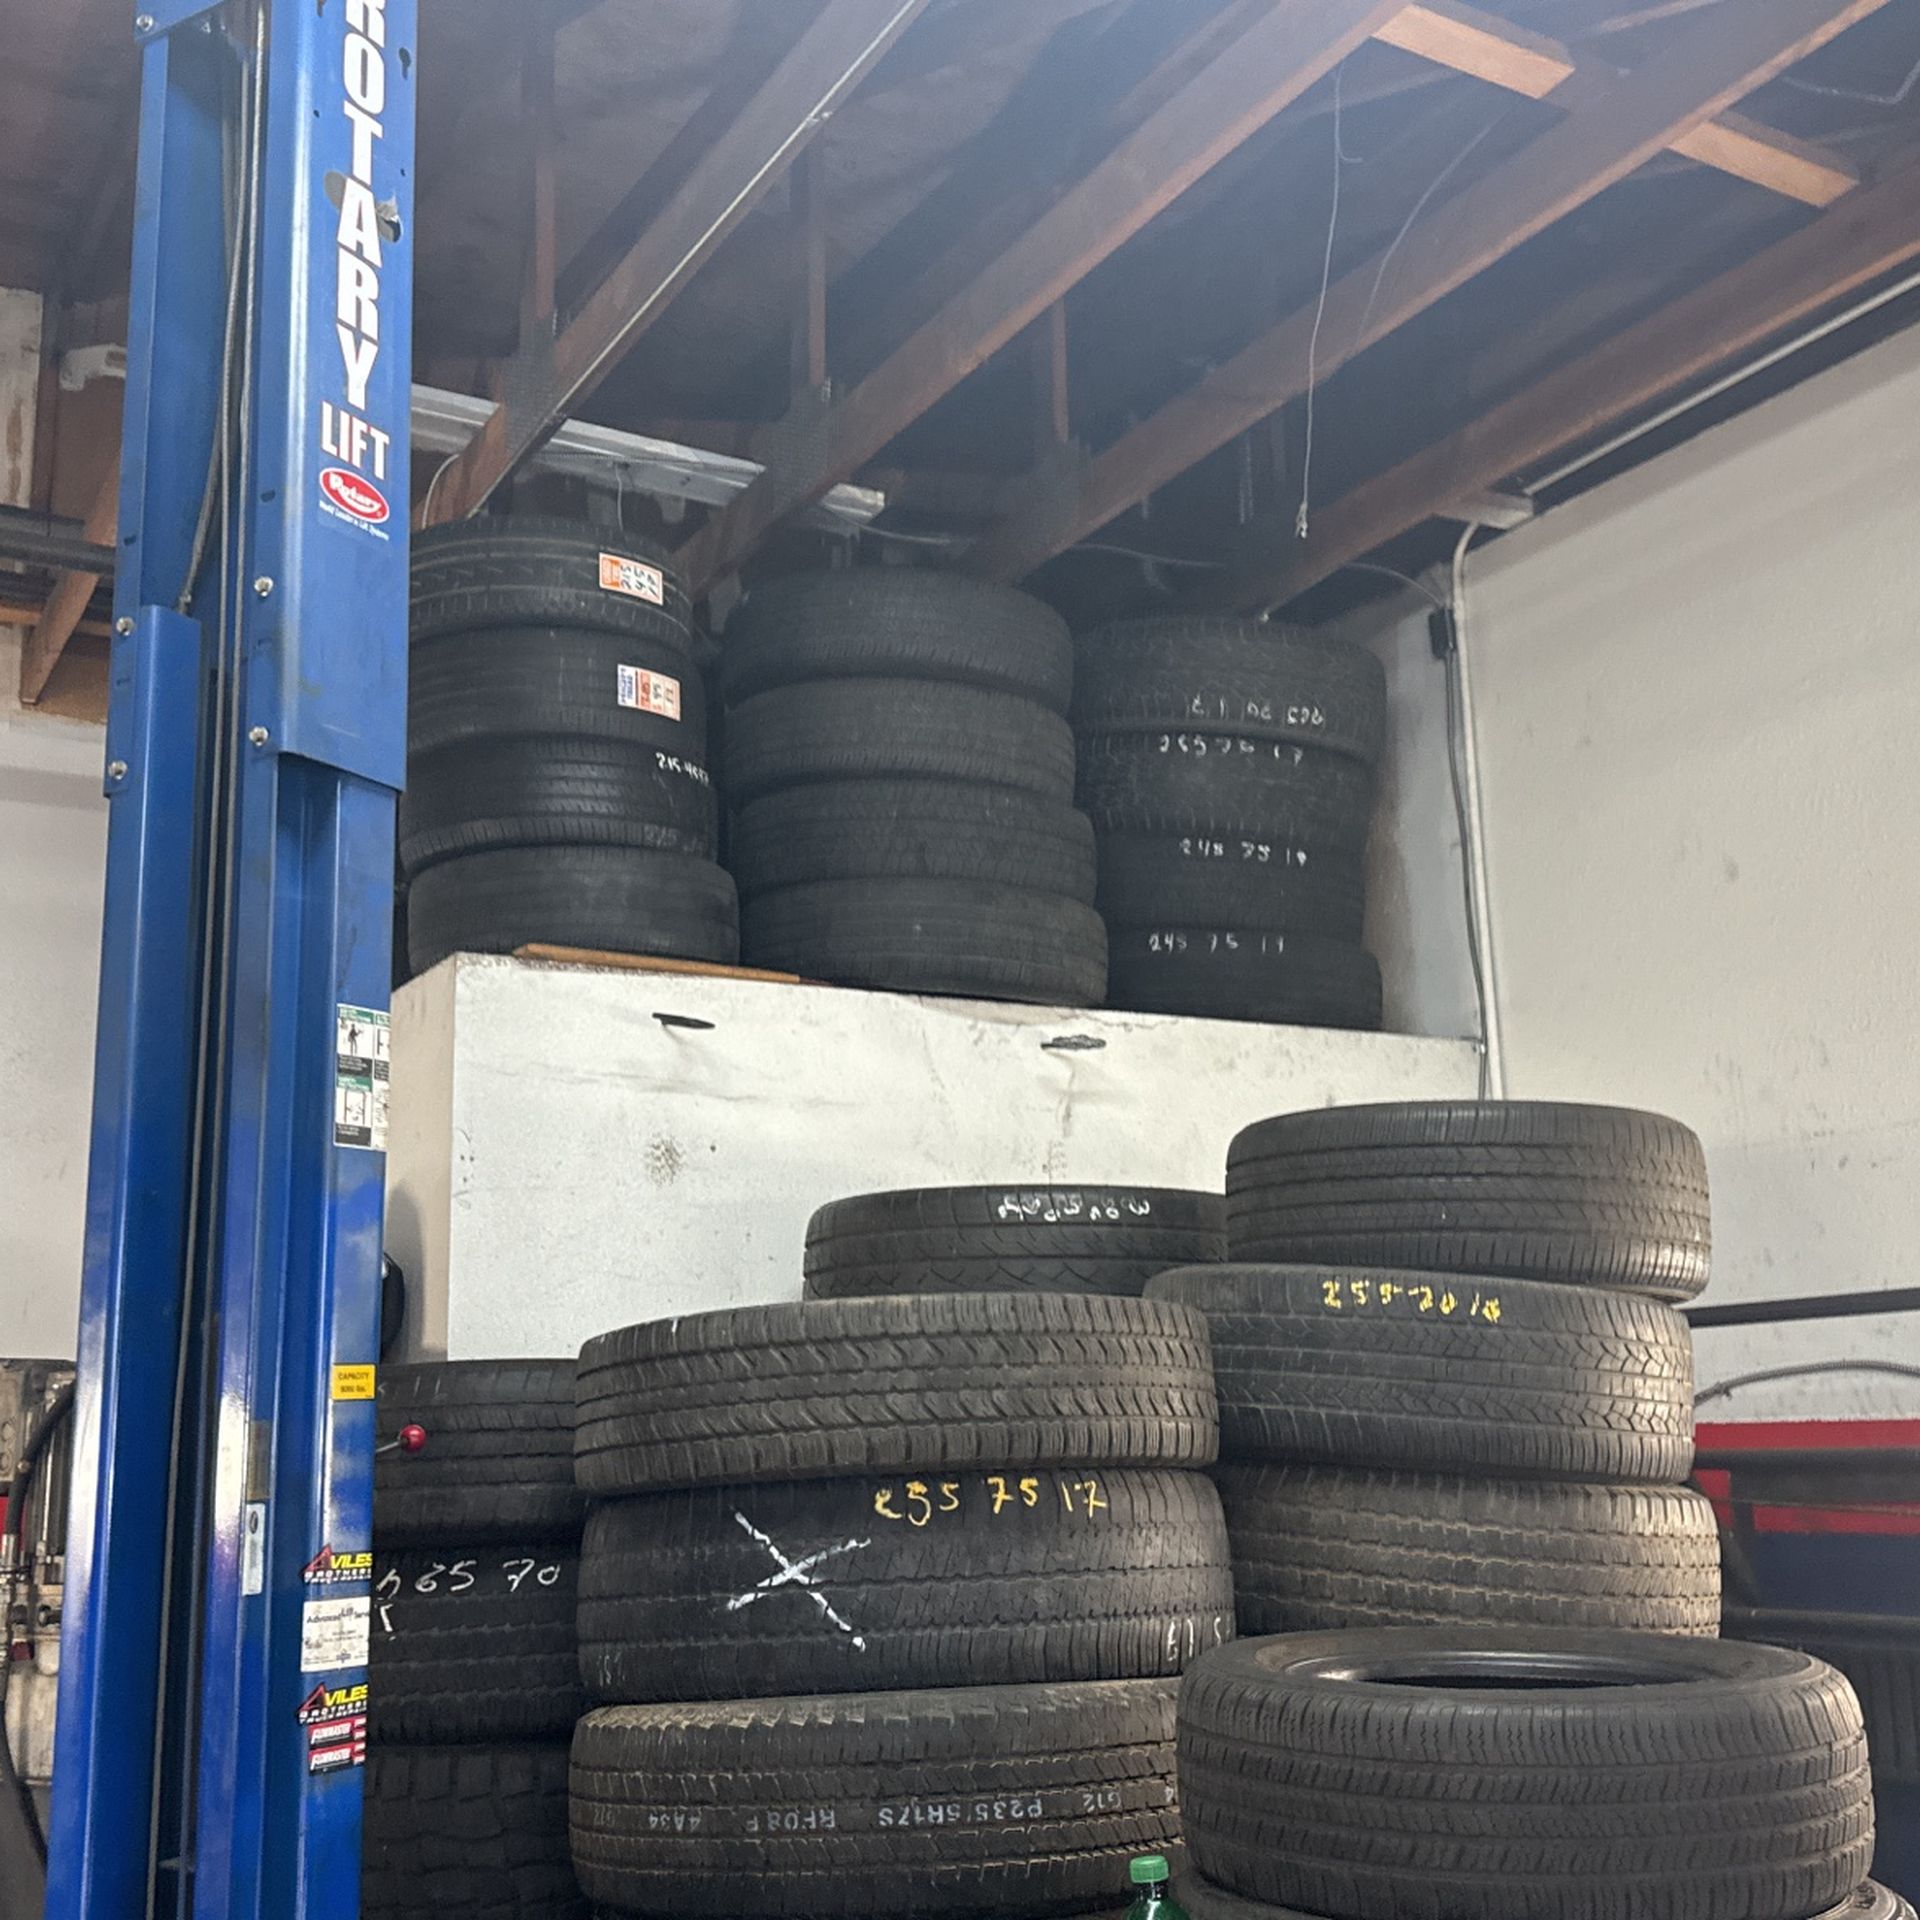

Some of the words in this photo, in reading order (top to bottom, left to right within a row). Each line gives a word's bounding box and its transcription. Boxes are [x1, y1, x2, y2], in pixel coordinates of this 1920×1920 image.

[322, 400, 390, 480] LIFT
[329, 472, 382, 513] Rotary
[987, 1476, 1039, 1515] 75
[1061, 1479, 1108, 1519] 17
[503, 1559, 561, 1593] 70
